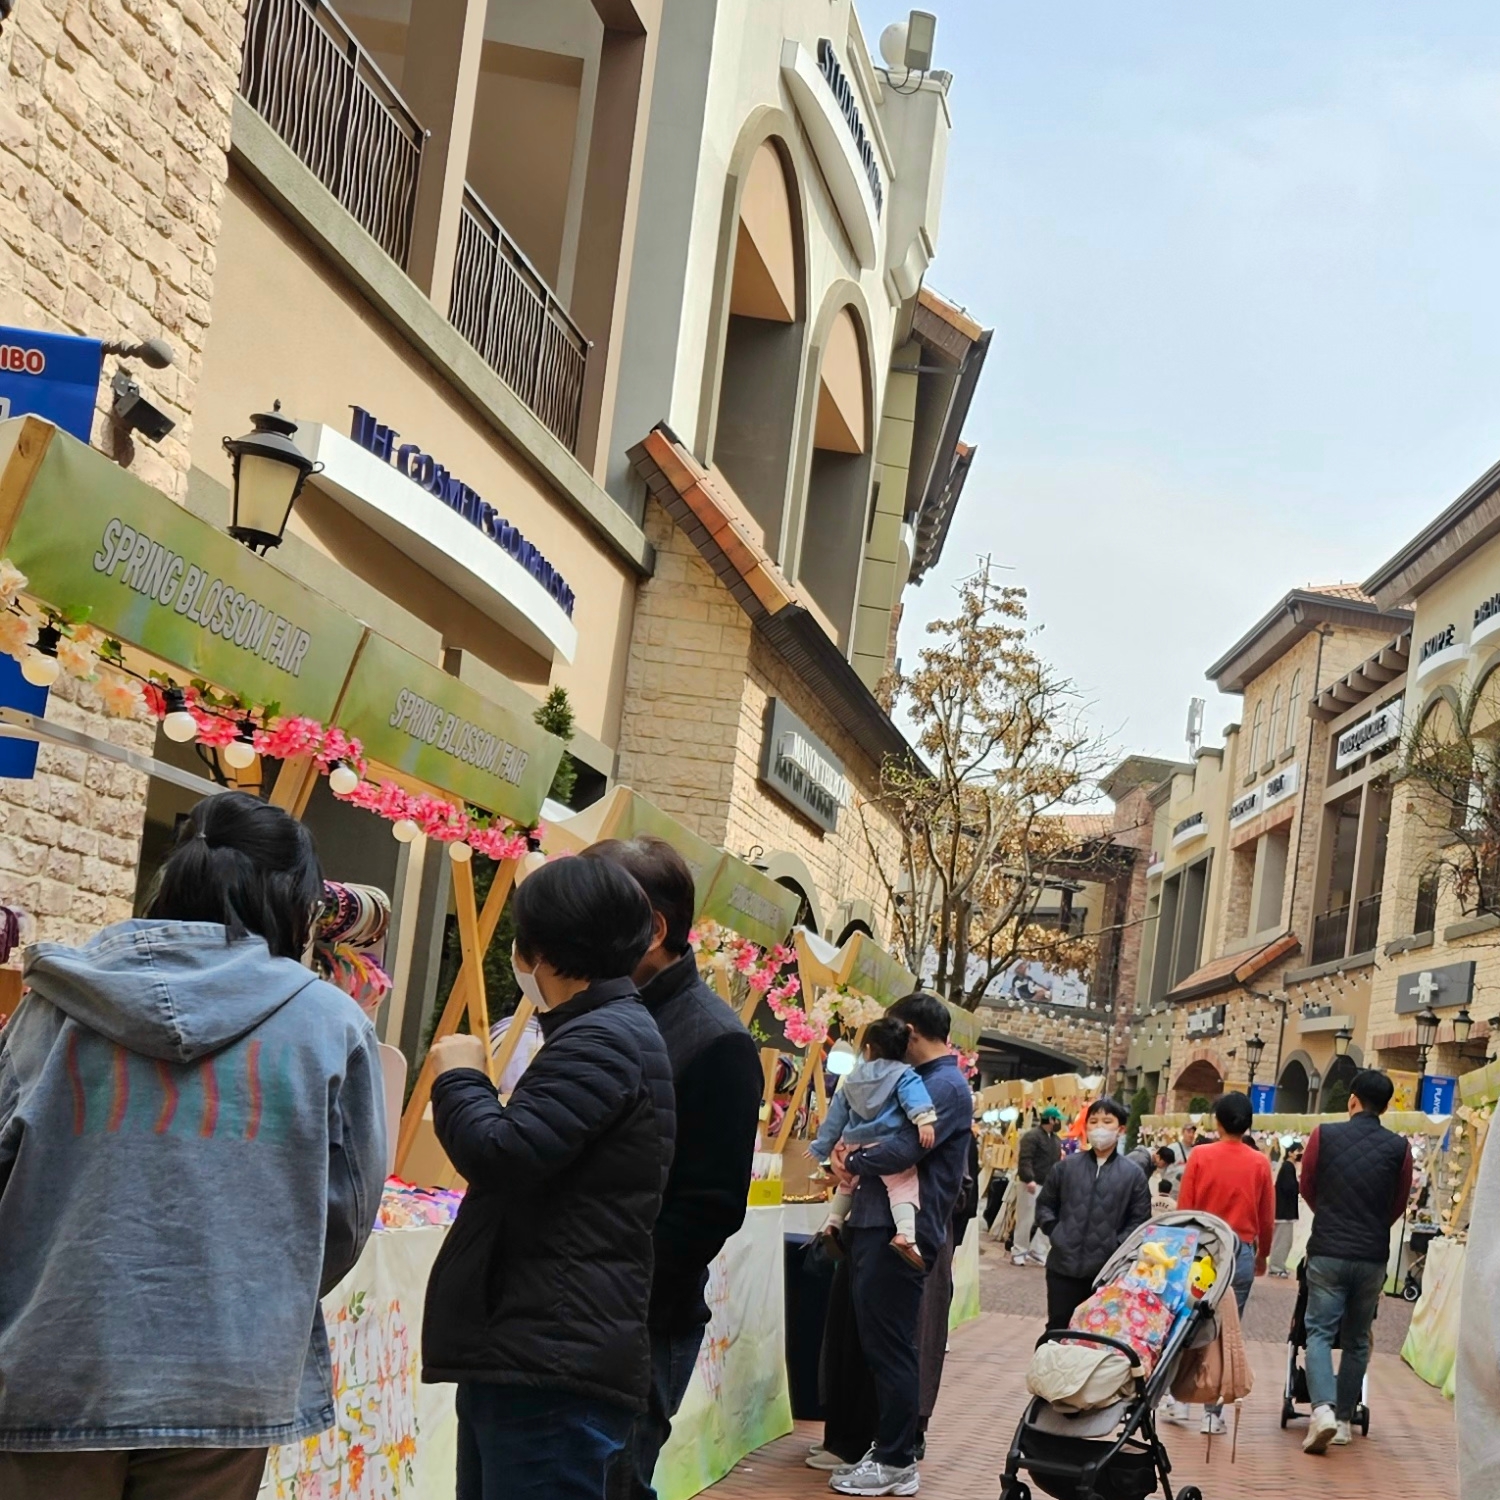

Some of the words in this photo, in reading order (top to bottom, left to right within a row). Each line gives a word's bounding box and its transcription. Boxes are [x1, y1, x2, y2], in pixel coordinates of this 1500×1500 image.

[93, 517, 184, 606] SPRING
[174, 562, 274, 656] BLOSSOM
[262, 614, 311, 678] FAIR
[389, 687, 444, 746] SPRING
[436, 712, 503, 774] BLOSSOM
[493, 741, 529, 788] FAIR
[326, 1310, 404, 1388] PRING
